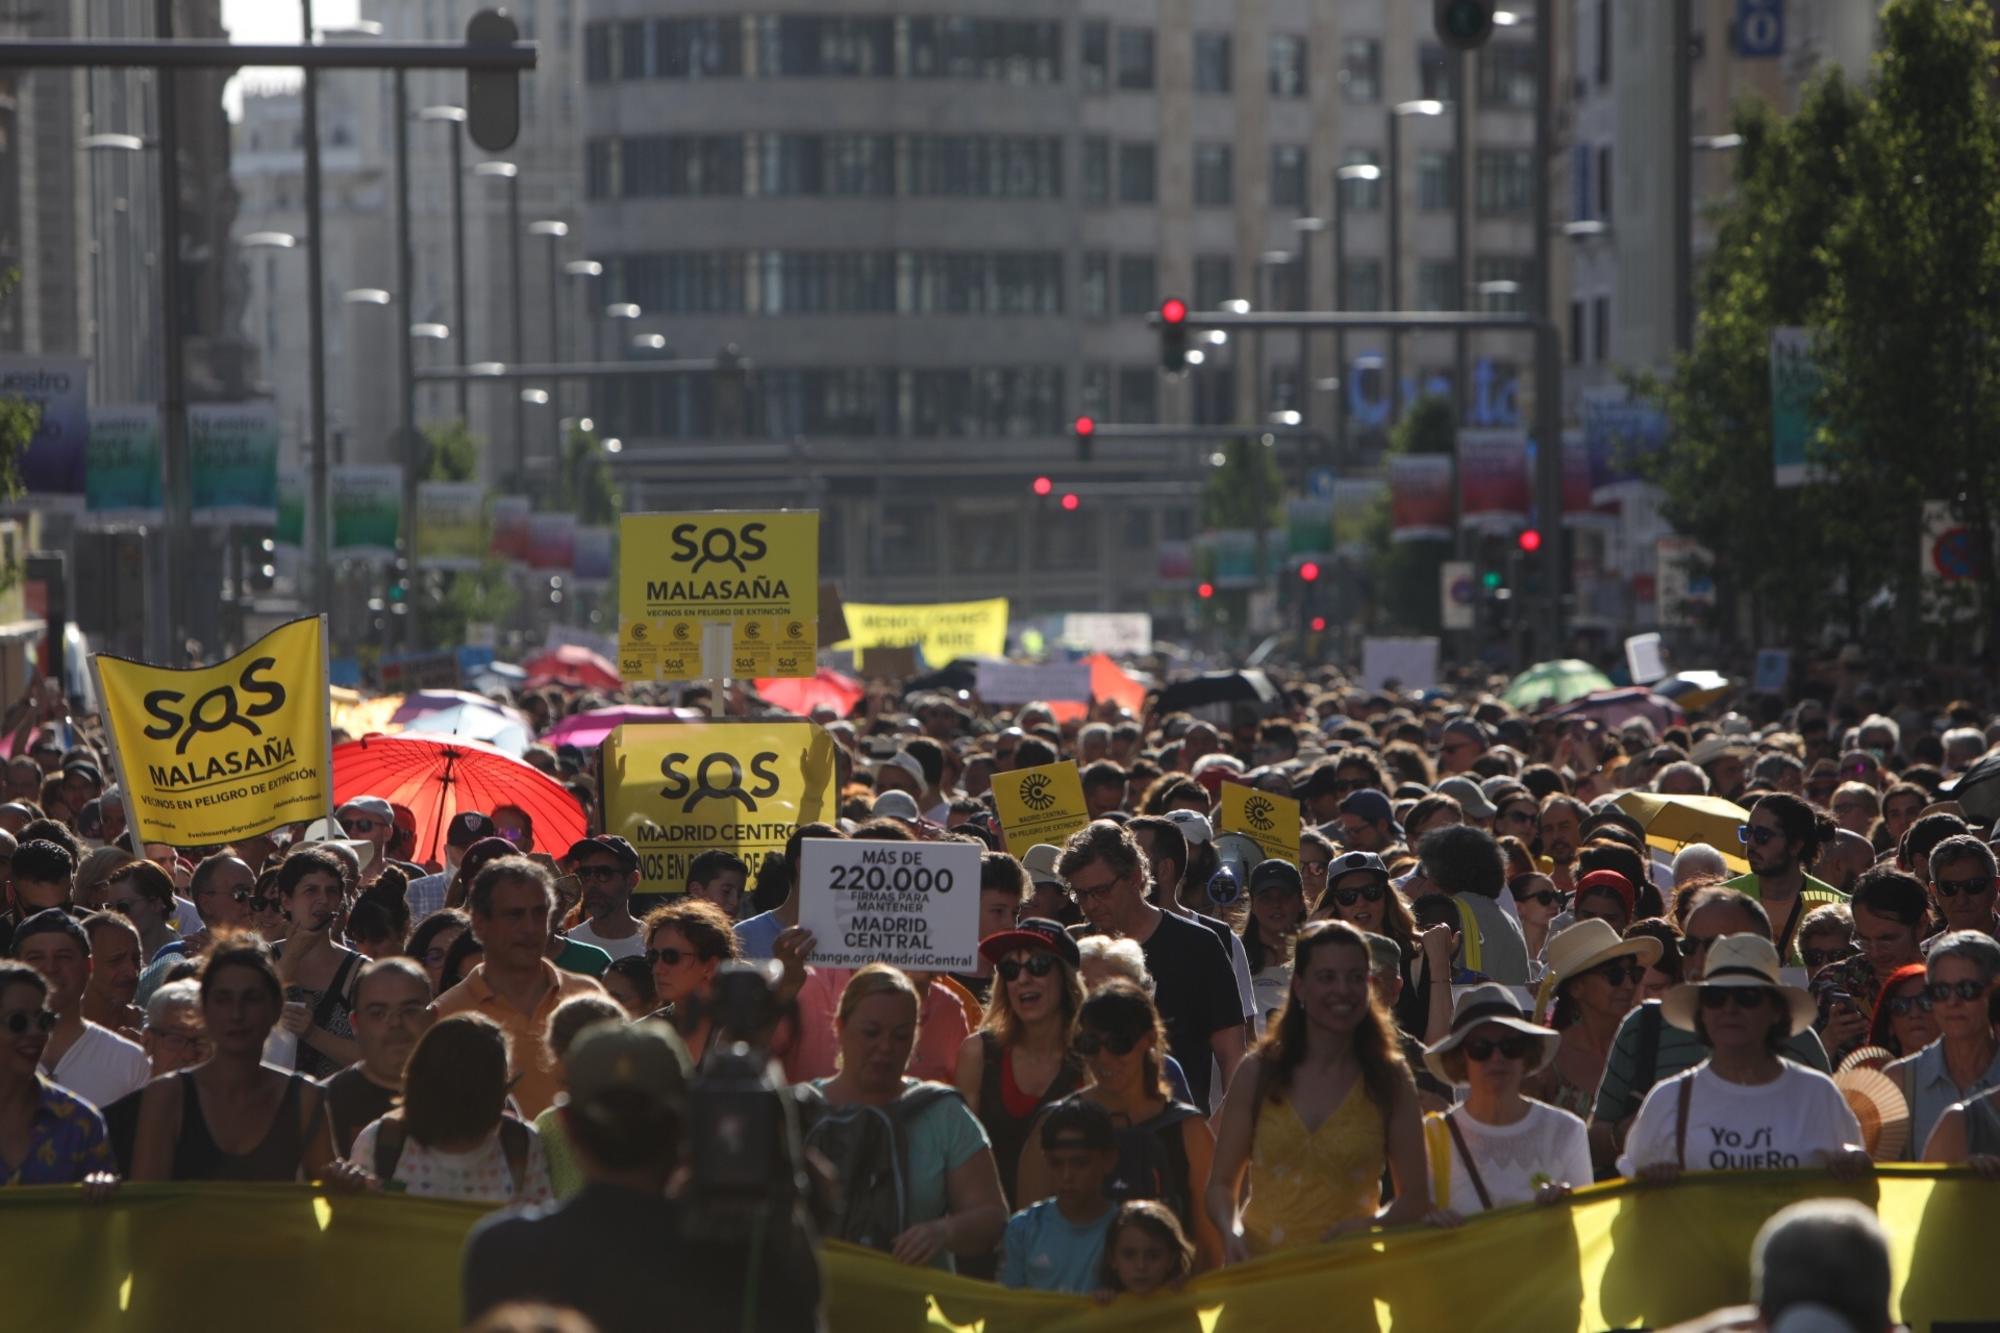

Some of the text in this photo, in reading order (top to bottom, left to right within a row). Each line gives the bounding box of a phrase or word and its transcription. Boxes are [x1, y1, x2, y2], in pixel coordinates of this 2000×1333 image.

[0, 366, 71, 394] uestro
[670, 522, 768, 574] SOS
[647, 575, 790, 600] MALASAÑA
[647, 607, 790, 617] VECINOS EN PELIGRO DE EXTINCIÓN
[143, 656, 286, 756] SOS
[149, 736, 295, 788] MALASAÑA
[141, 766, 317, 811] VECINOS EN PELIGRO DE EXTINCIÓN
[659, 751, 780, 814] SOS
[637, 825, 716, 843] MADRID
[667, 854, 684, 881] EN
[862, 848, 923, 866] MÁS DE
[829, 865, 953, 894] 220.000
[850, 891, 930, 903] FIRMAS PARA
[856, 902, 923, 913] MANTENER
[851, 916, 927, 933] MADRID
[844, 932, 933, 950] CENTRAL
[1710, 1126, 1741, 1148] Yo
